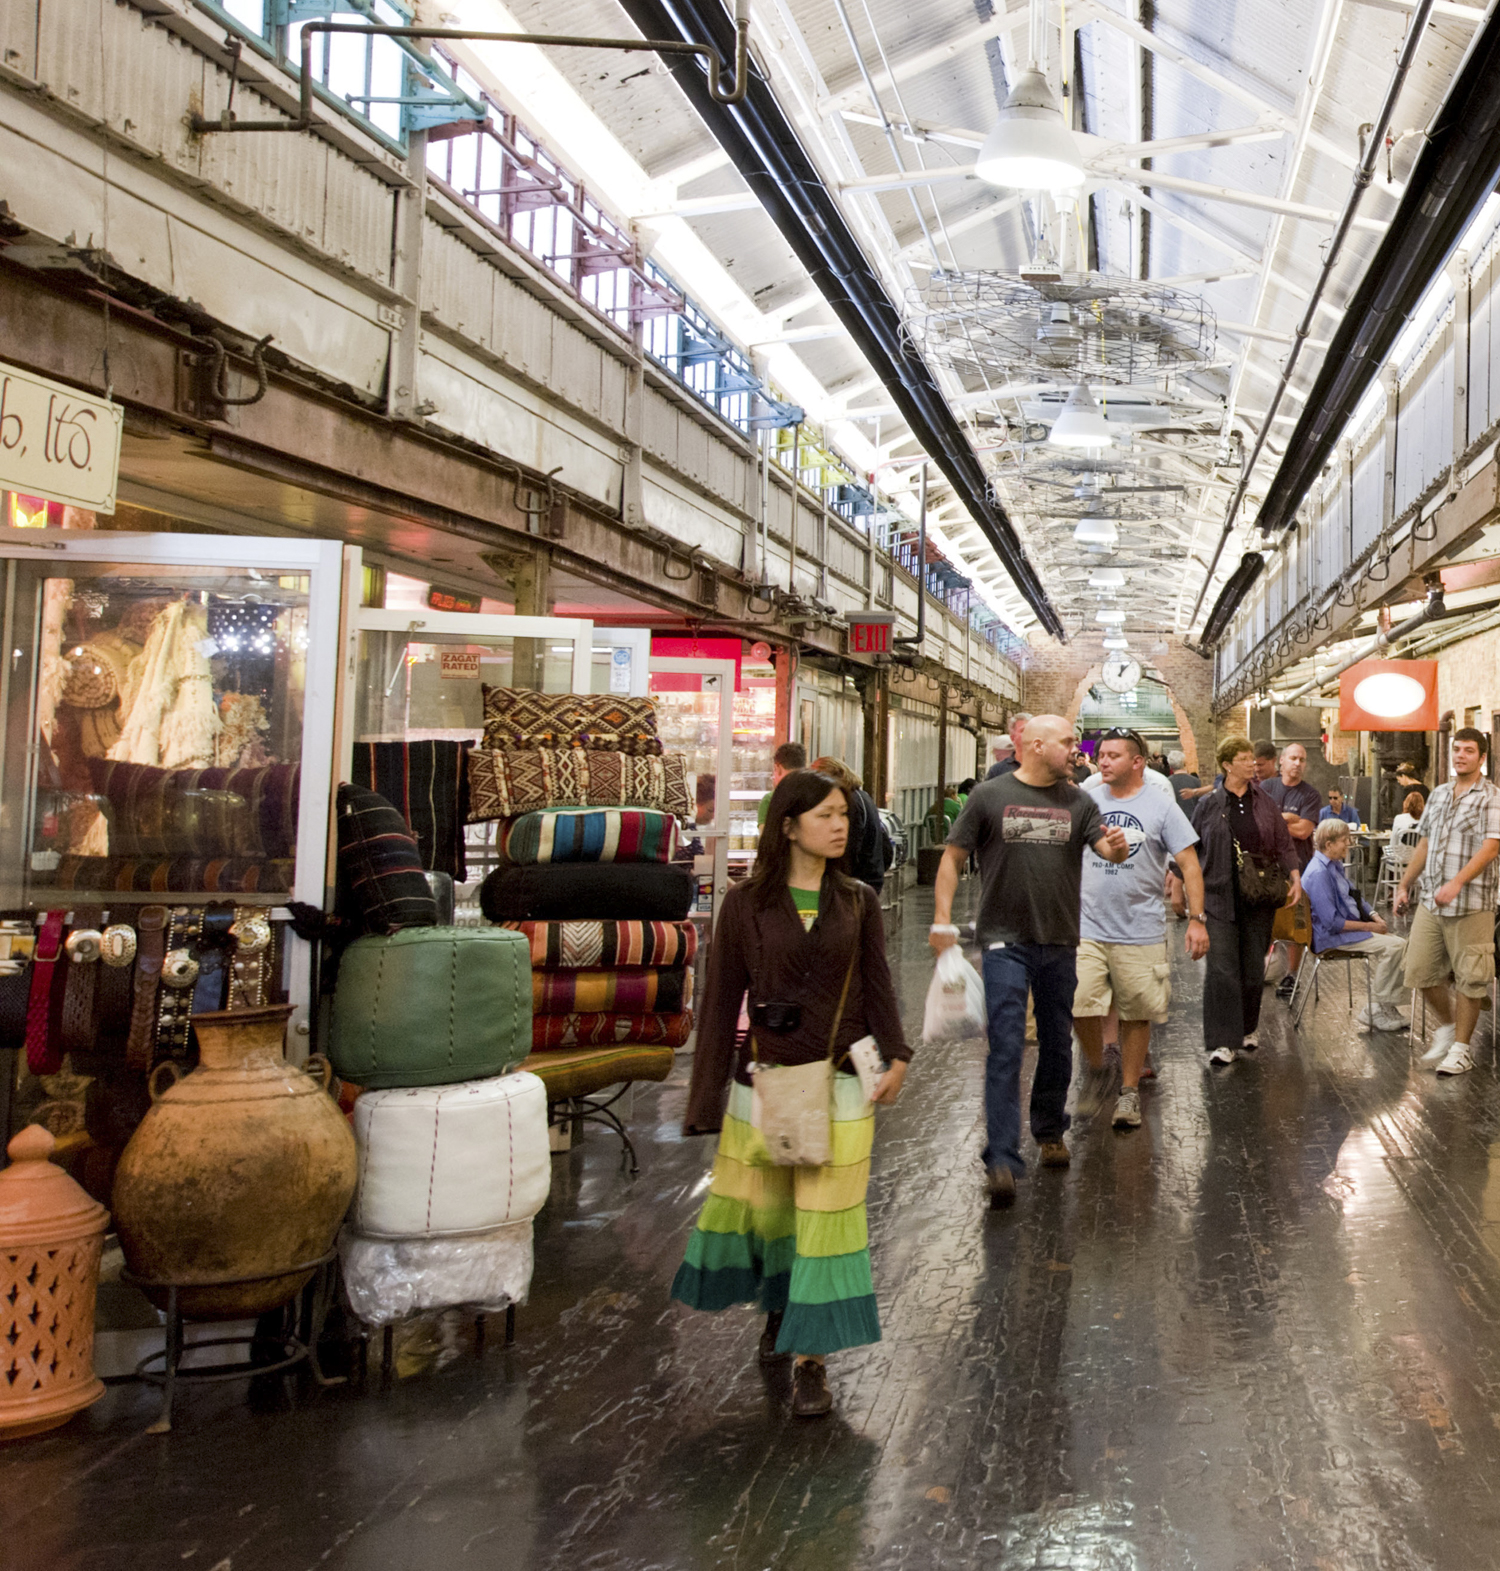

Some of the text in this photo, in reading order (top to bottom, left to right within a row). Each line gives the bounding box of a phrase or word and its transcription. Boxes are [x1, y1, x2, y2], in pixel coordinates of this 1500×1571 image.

[855, 624, 889, 652] EXIT
[1008, 807, 1053, 821] Raceway
[1103, 815, 1139, 830] ALIF.
